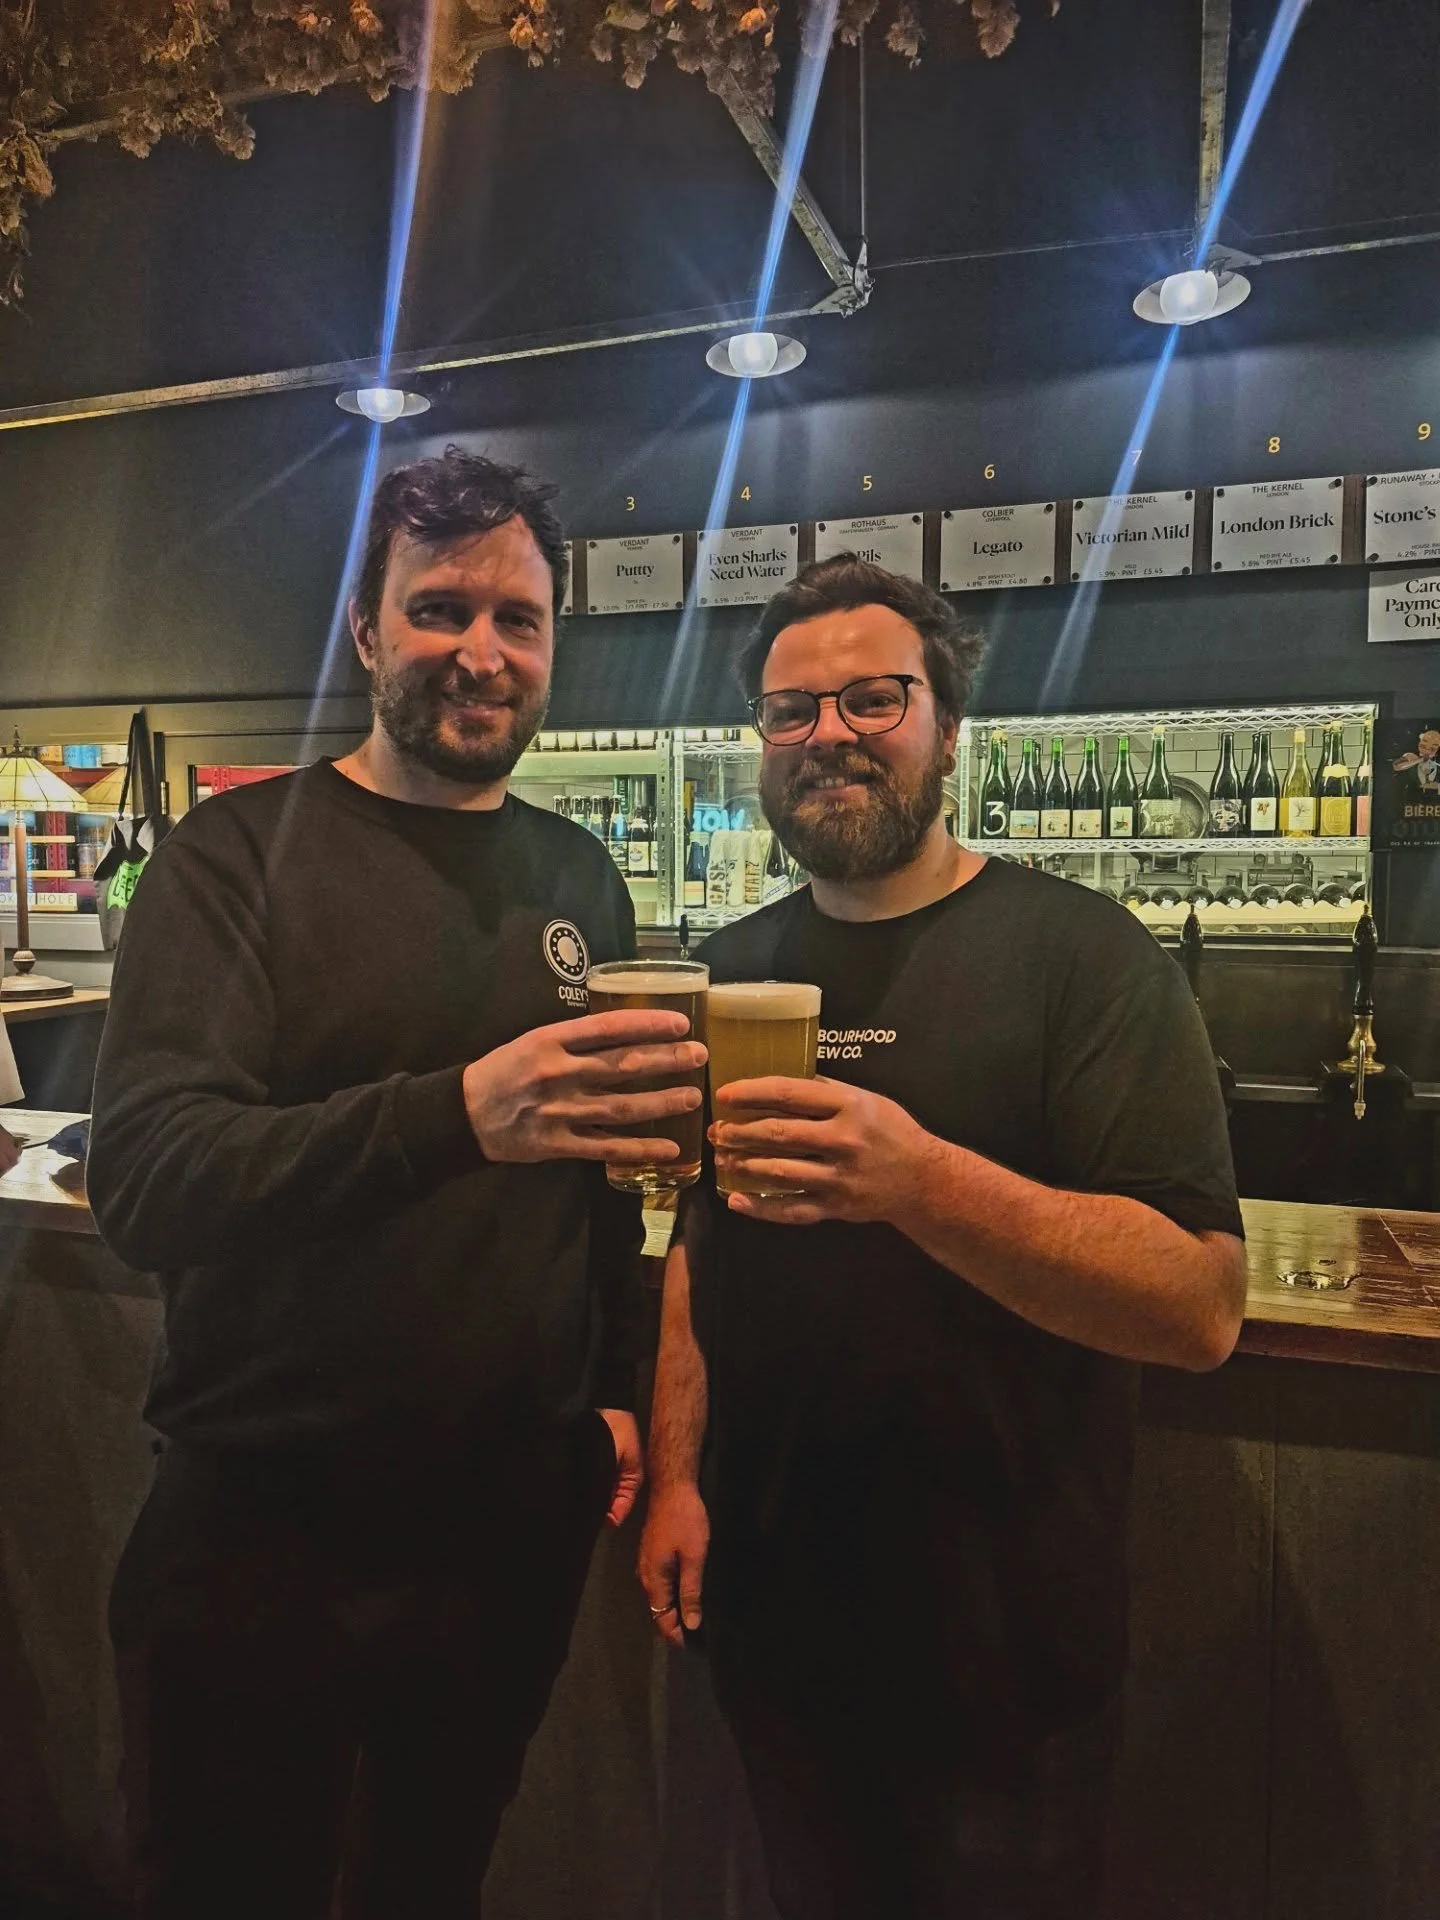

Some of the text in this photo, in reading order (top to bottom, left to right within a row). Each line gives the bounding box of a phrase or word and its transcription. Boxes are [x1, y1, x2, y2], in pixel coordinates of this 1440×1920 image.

[1417, 422, 1431, 441] 9
[1268, 436, 1281, 453] 8
[1131, 449, 1143, 465] 7
[984, 464, 995, 479] 6
[1380, 473, 1427, 485] RUNAWAY
[862, 475, 873, 491] 5
[1252, 482, 1304, 494] THE KERNEL
[740, 486, 751, 501] 4
[1126, 495, 1158, 505] KERNEL
[625, 496, 635, 511] 3
[982, 508, 1015, 518] COLBIER
[1373, 506, 1437, 525] Stone's
[851, 518, 887, 529] ROTHAUS
[1220, 512, 1334, 534] London Brick
[731, 528, 763, 538] VERDANT
[1075, 523, 1190, 545] Victorian Mild
[619, 538, 650, 547] VERDANT
[973, 541, 1023, 556] Legato
[709, 548, 787, 566] Even Sharks
[856, 549, 882, 563] Pils
[1266, 558, 1283, 566] PINT
[616, 564, 654, 578] Putty
[710, 565, 787, 581] Need Water
[983, 801, 1007, 836] 3
[39, 893, 74, 905] HOLE
[817, 1029, 896, 1044] BOURHOOD
[816, 1045, 863, 1059] EW CO.
